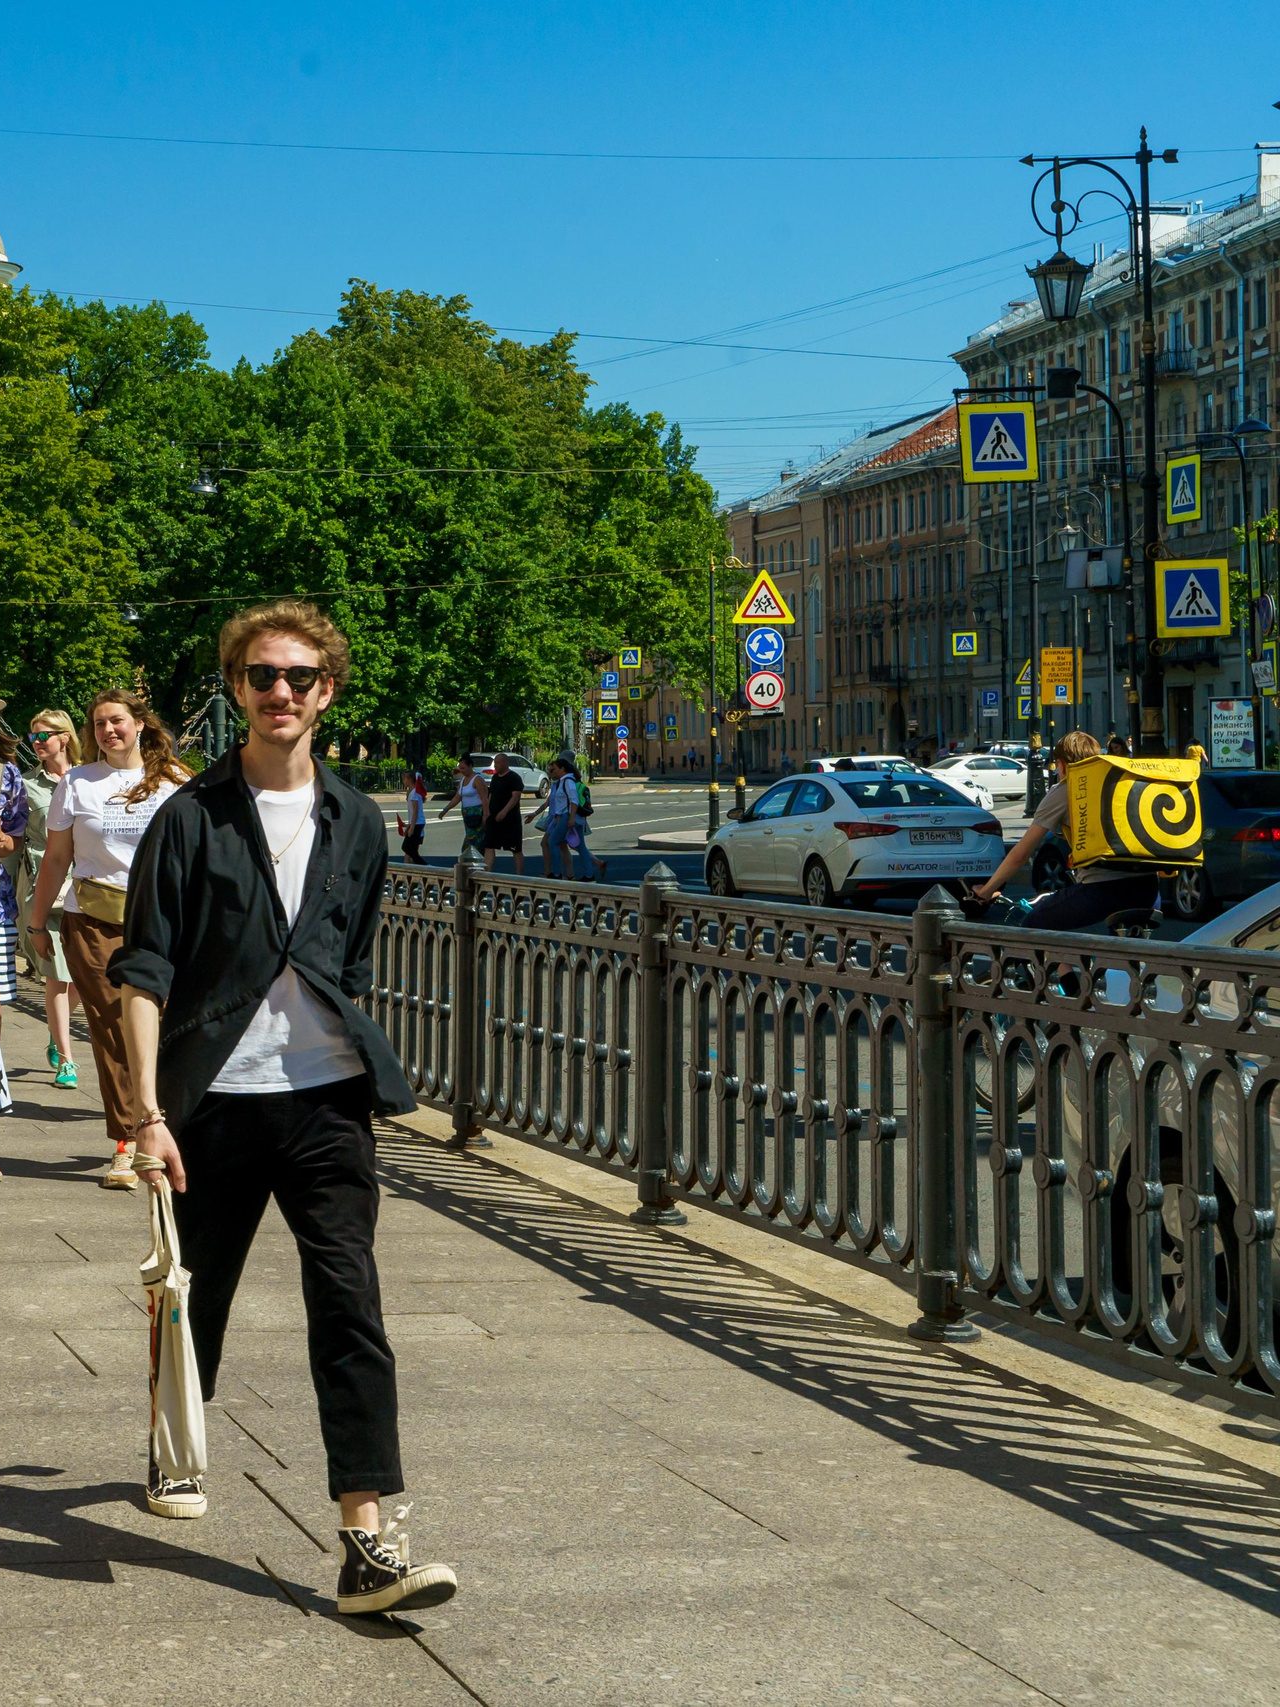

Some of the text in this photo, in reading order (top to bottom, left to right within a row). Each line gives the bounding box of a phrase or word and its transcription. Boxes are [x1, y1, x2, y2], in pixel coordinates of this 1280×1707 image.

[754, 683, 776, 697] 40
[1128, 760, 1181, 773] Яндекс Еда
[1075, 775, 1088, 851] Яндекс Еда
[888, 863, 938, 871] NAVIGATOR
